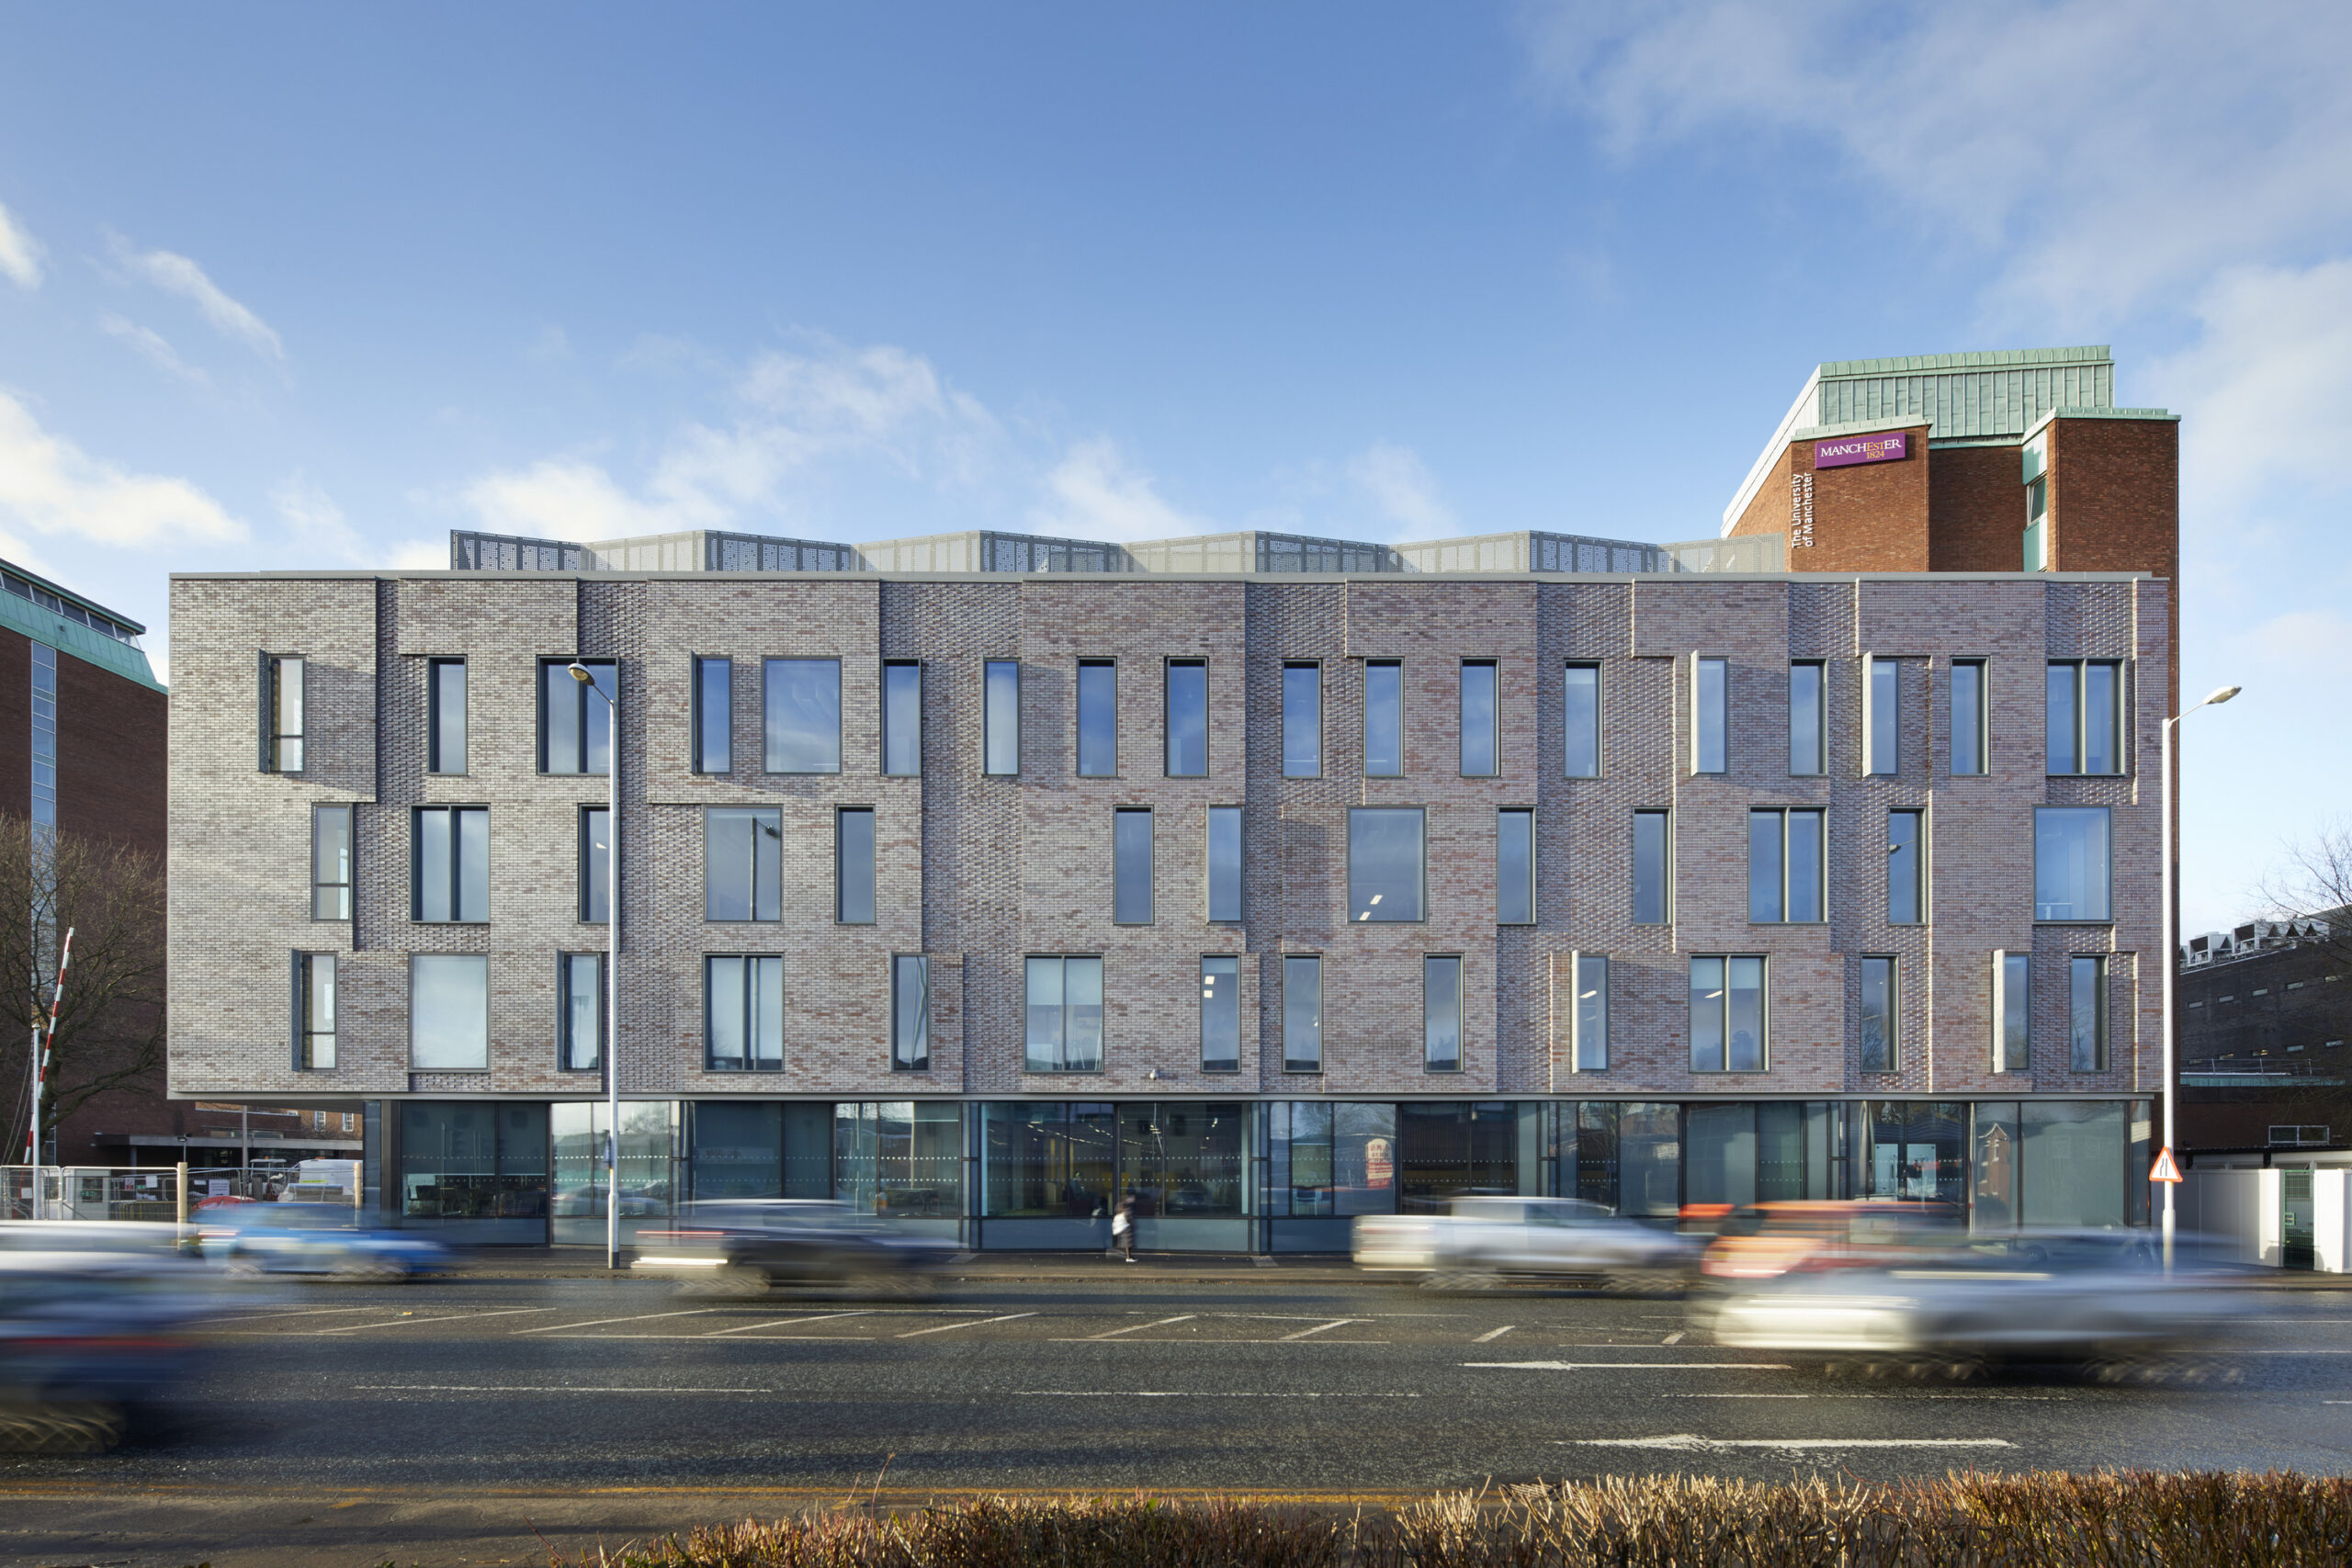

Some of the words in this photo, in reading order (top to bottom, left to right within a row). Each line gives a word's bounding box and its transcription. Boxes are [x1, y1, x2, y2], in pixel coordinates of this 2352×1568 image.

[1820, 438, 1902, 457] MANCHESTER
[1867, 450, 1884, 459] 1824
[1792, 474, 1804, 526] University
[1802, 472, 1813, 534] Manchester
[1792, 529, 1802, 548] The
[1803, 536, 1813, 547] of
